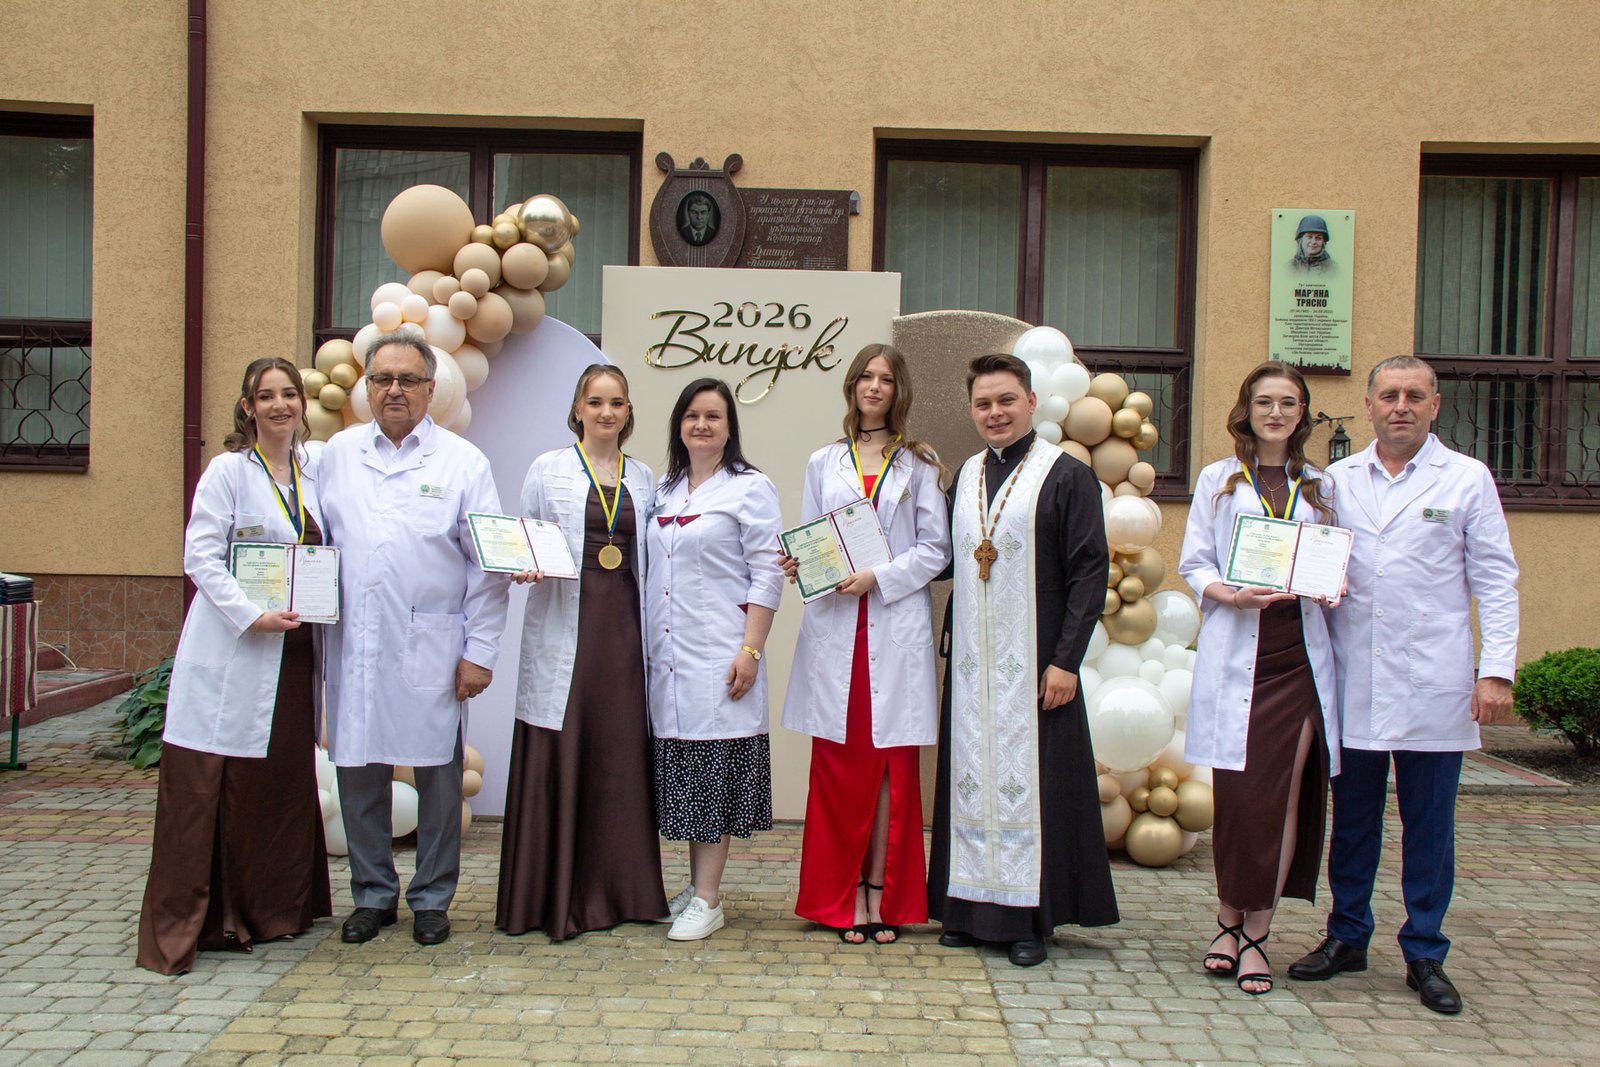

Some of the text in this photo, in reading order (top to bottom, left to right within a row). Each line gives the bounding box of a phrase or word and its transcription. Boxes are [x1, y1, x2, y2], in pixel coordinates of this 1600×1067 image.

[1294, 289, 1329, 298] МАР'ЯНА
[1296, 299, 1327, 307] ТРЯСКО
[713, 302, 812, 329] 2026
[645, 310, 849, 404] Випуск
